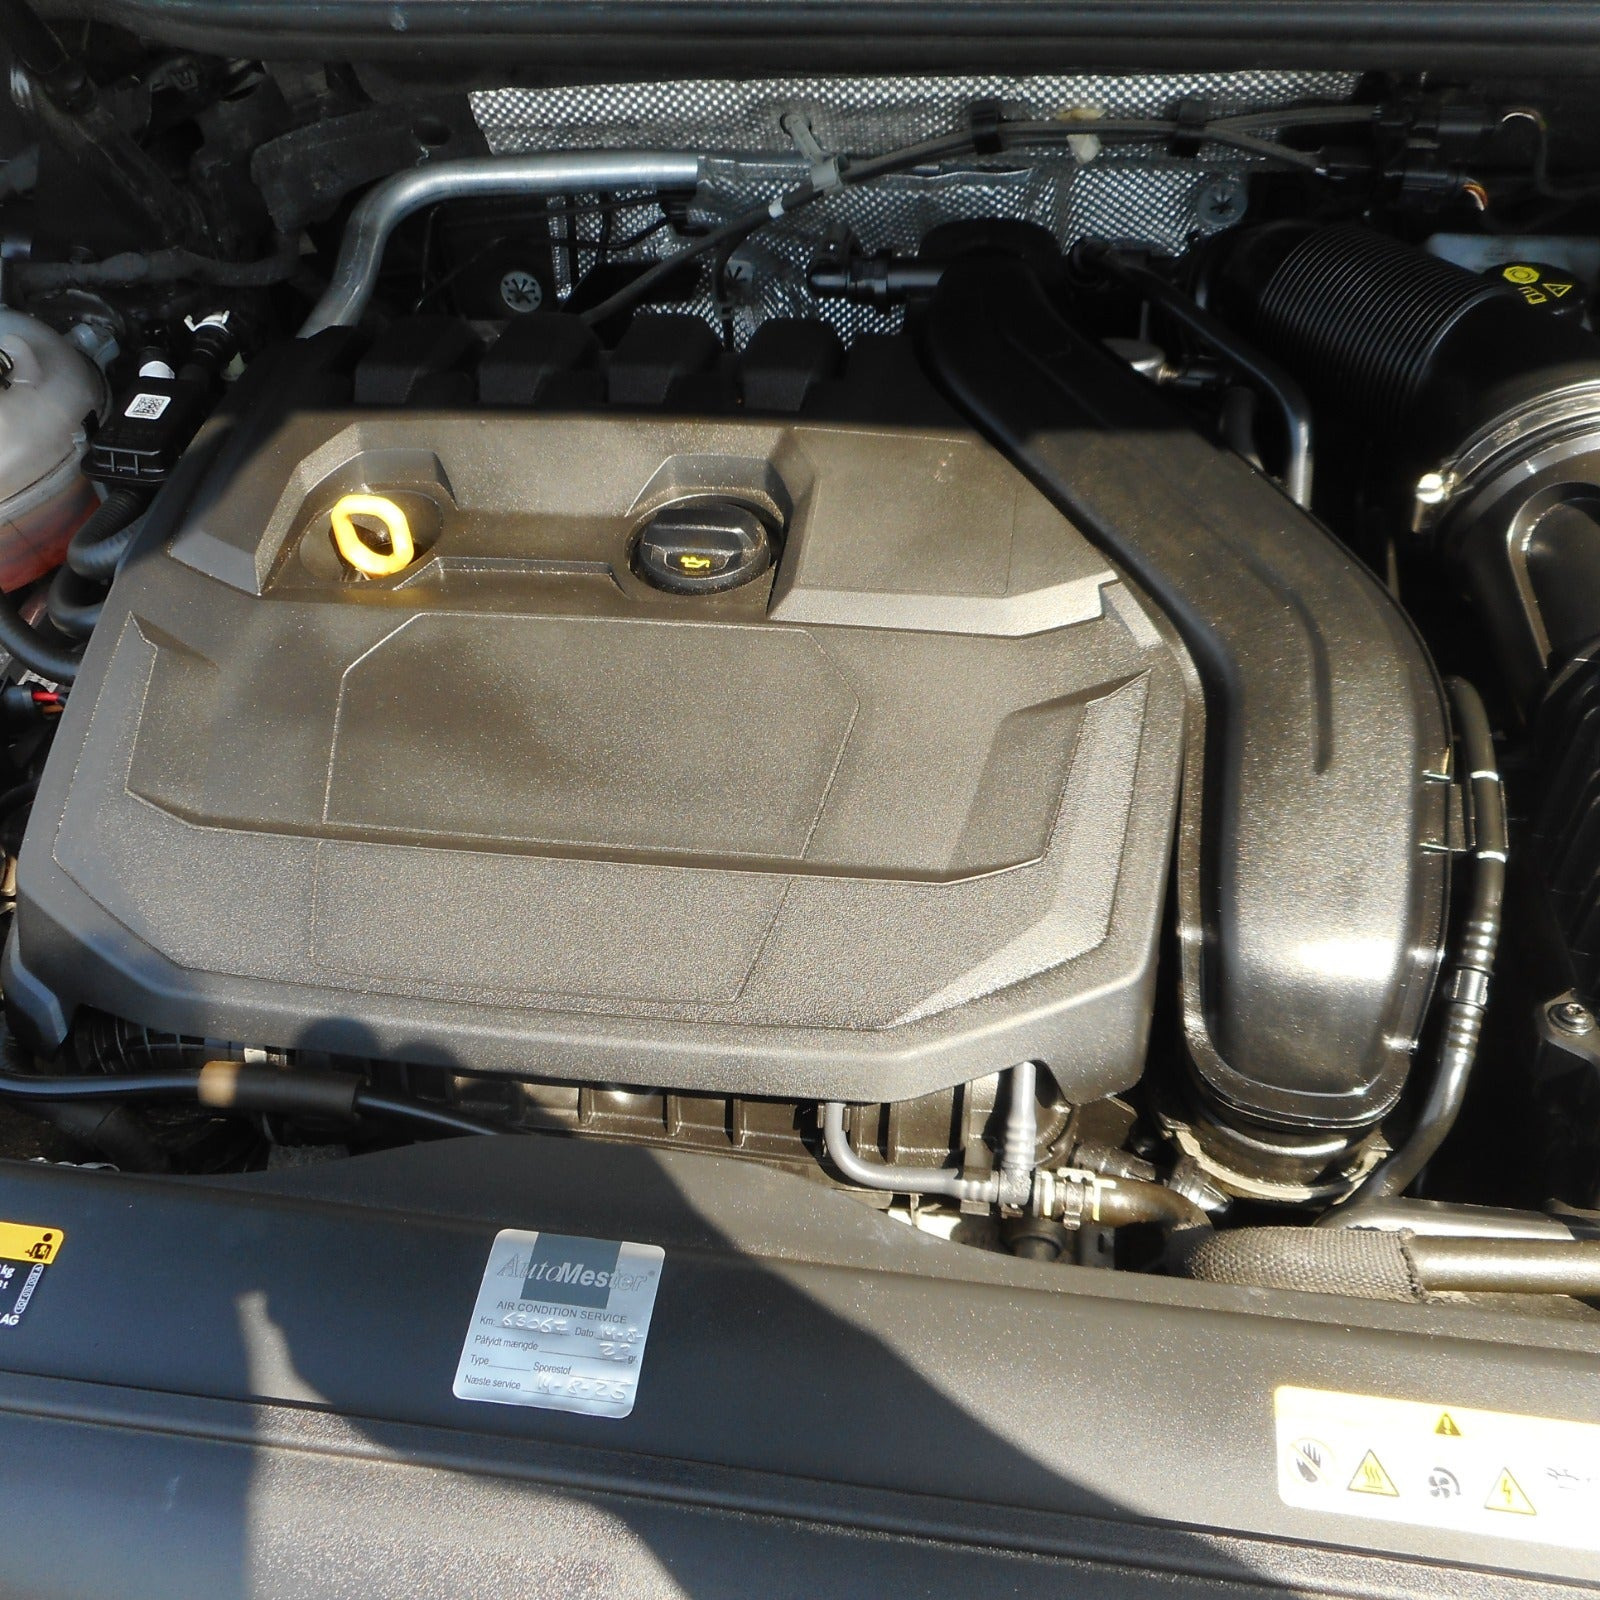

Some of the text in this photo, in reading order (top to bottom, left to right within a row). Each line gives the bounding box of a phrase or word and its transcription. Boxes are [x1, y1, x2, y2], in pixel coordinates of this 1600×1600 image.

[497, 1253, 647, 1291] AutoMester
[0, 1313, 20, 1326] AG
[497, 1301, 628, 1324] AIR CONDITION SERVICE
[575, 1327, 594, 1338] Dato
[474, 1334, 539, 1352] Påfyldt mængde
[471, 1354, 489, 1366] Type
[533, 1361, 572, 1375] Sporestof
[464, 1374, 520, 1390] Næste service
